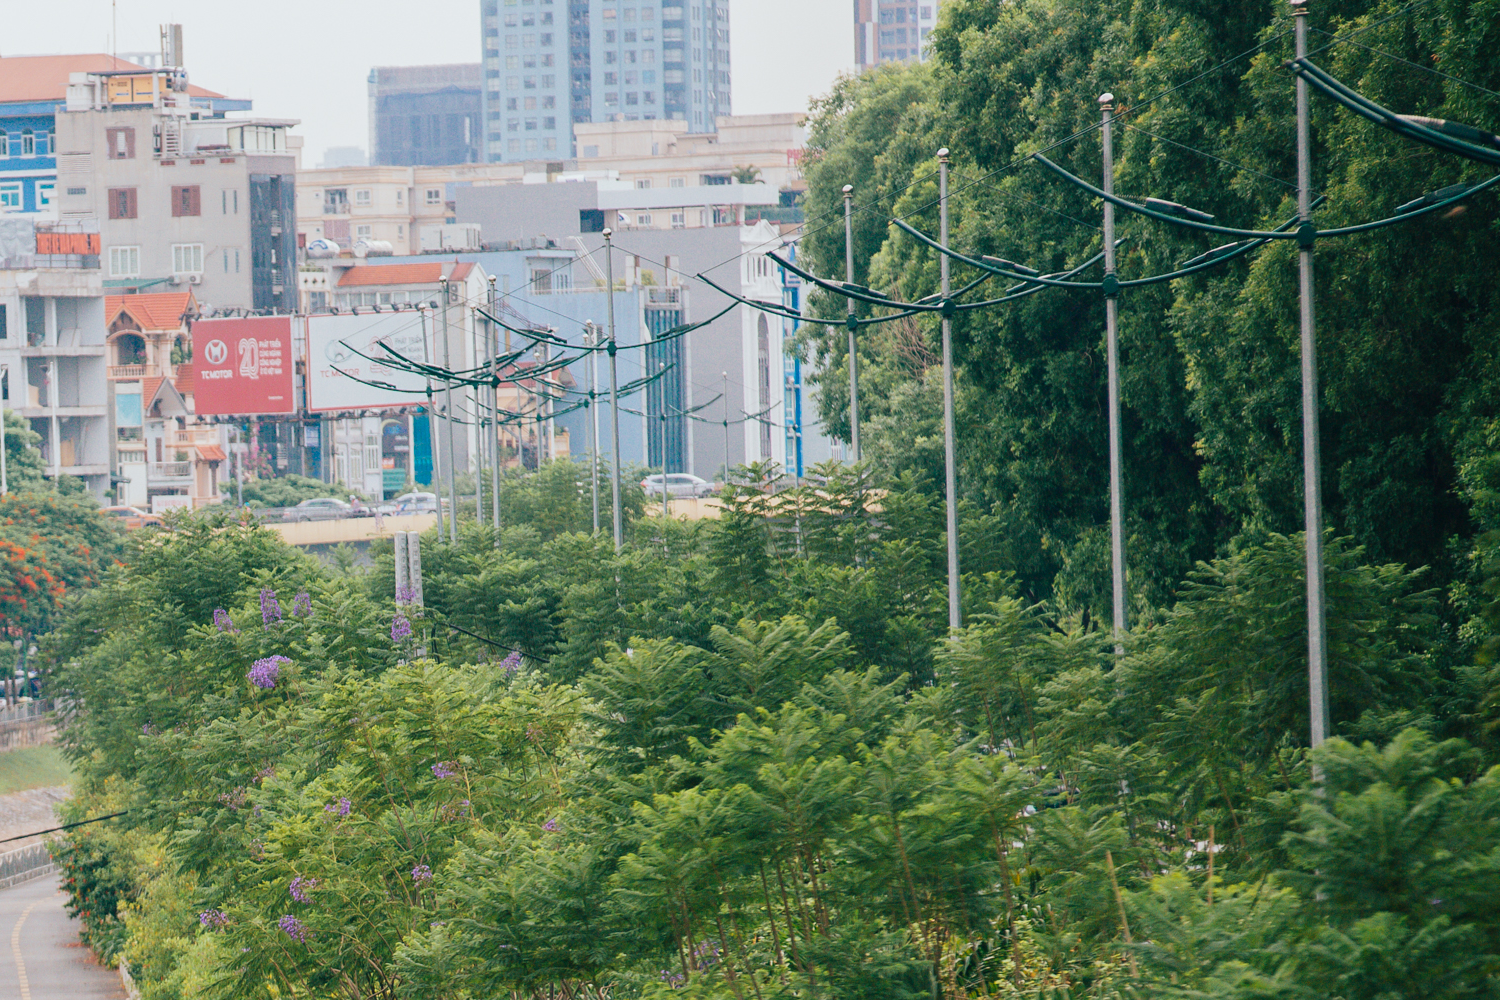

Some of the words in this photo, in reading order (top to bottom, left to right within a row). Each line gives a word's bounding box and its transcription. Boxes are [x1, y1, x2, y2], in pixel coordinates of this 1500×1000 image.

[201, 370, 210, 379] TC
[210, 369, 233, 379] MOTOR
[320, 370, 330, 378] TC
